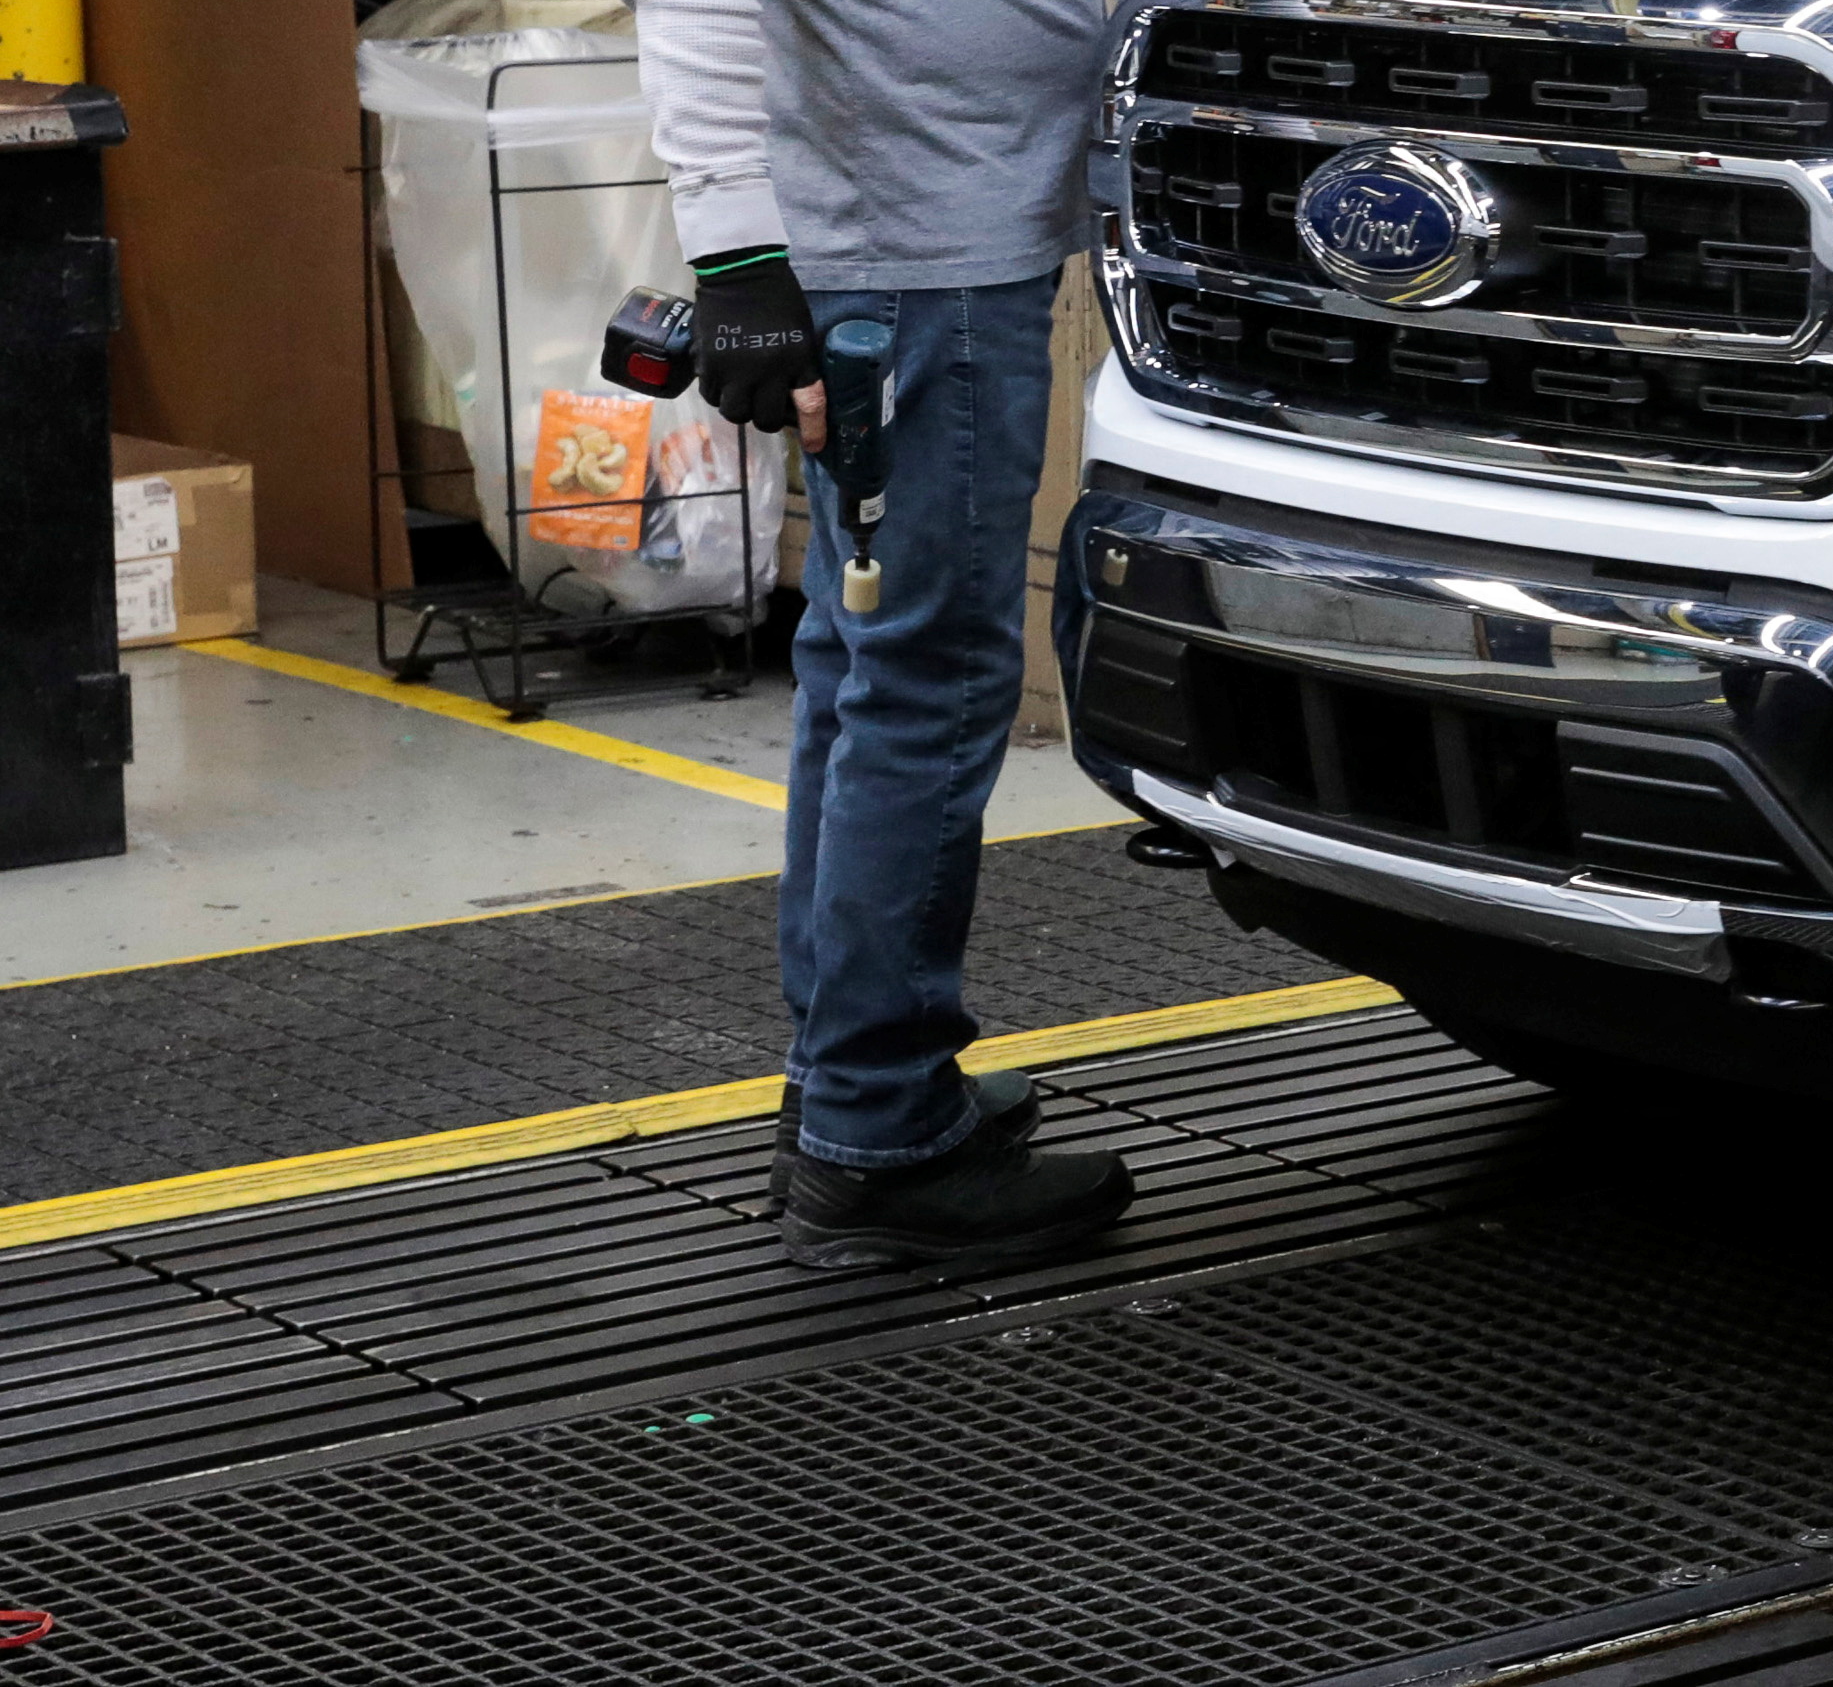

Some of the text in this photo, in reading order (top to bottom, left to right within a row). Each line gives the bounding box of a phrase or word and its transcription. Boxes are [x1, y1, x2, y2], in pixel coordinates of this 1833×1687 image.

[1331, 185, 1421, 257] Ford
[718, 324, 741, 334] PU
[715, 330, 804, 351] SIZE:10
